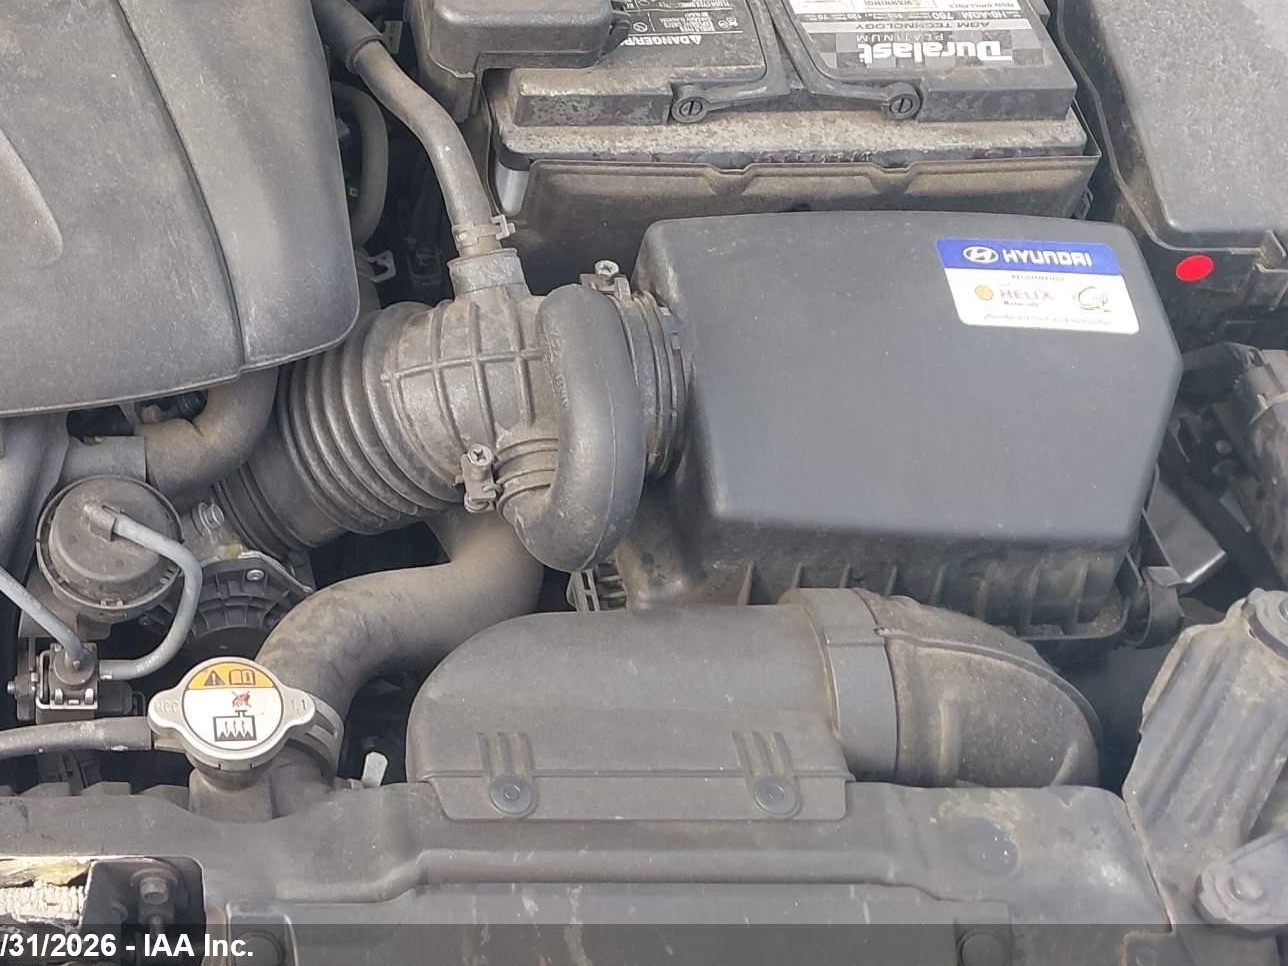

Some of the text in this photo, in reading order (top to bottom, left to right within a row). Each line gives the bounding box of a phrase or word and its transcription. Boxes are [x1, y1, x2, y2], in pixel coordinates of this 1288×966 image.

[855, 22, 953, 30] TECHNOLOGY
[856, 34, 944, 42] PLATINUM
[857, 40, 1013, 64] Duralast
[1002, 248, 1093, 267] HYUNDAI
